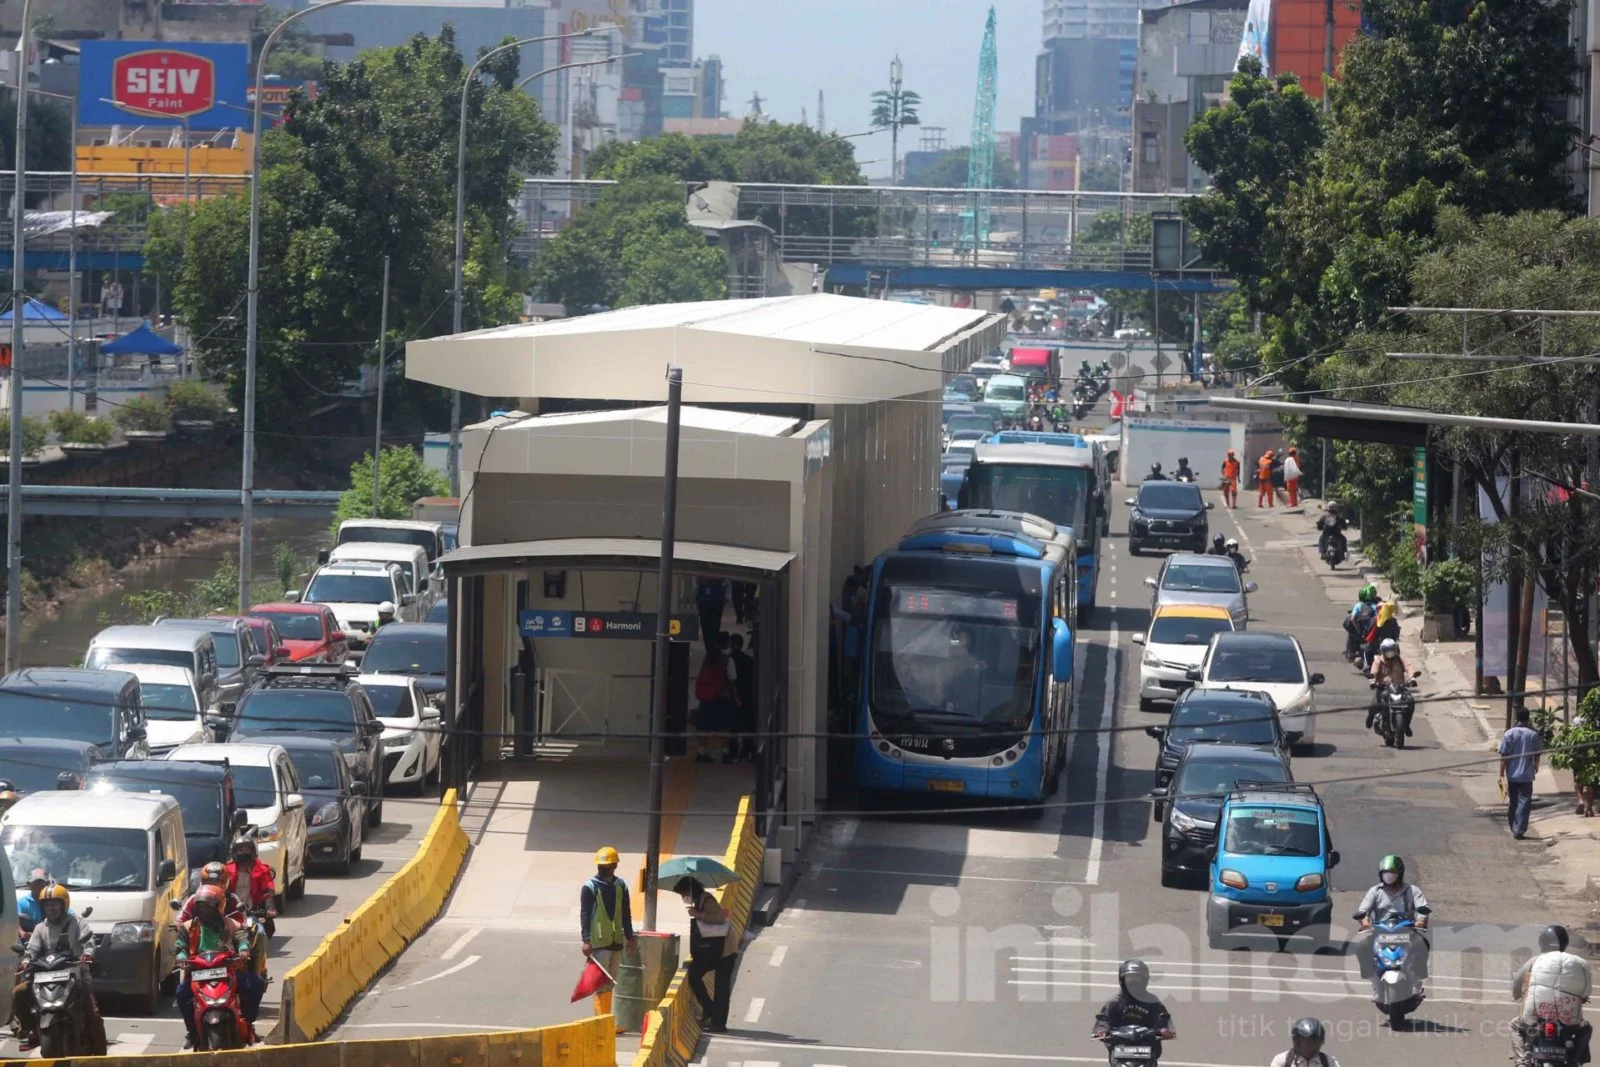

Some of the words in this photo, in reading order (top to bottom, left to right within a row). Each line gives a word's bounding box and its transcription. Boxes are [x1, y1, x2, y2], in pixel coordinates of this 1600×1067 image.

[126, 67, 200, 94] SEIV
[147, 98, 183, 109] Paint
[606, 621, 641, 631] Harmoni
